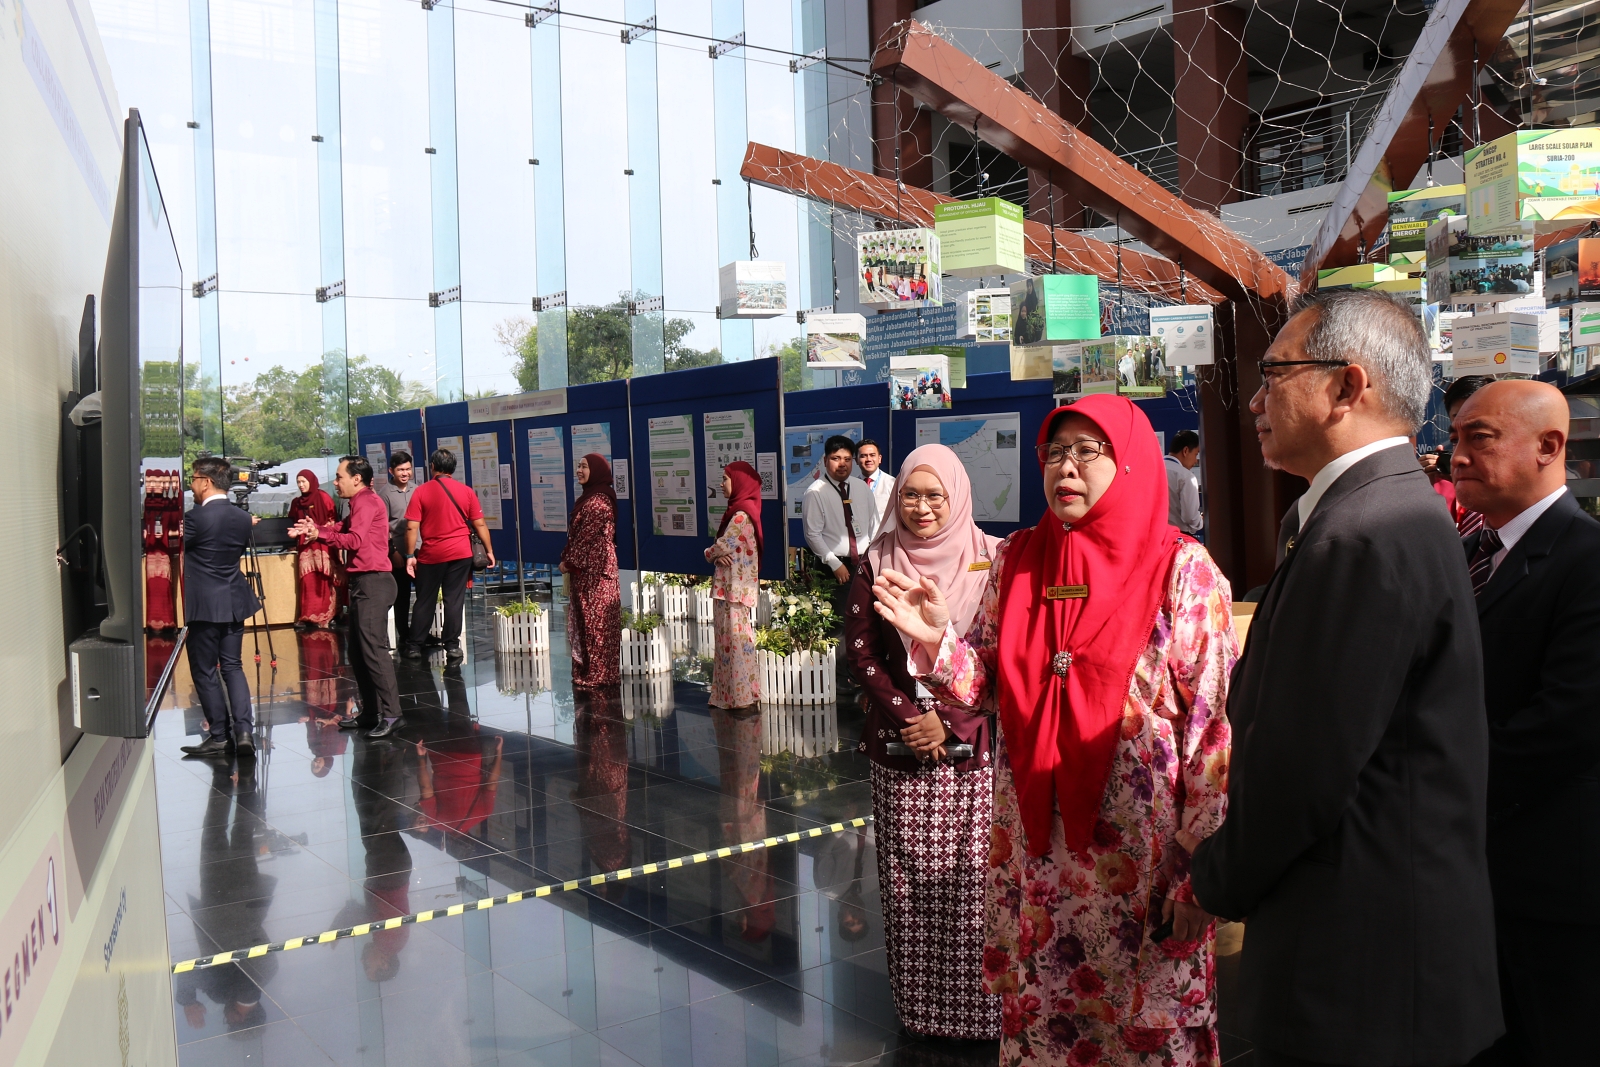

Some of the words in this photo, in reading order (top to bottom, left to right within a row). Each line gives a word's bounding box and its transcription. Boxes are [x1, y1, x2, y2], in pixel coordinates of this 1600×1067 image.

[1528, 143, 1544, 151] LARGE
[1547, 154, 1575, 162] SURIA-200
[1475, 156, 1495, 170] STRATEGY
[944, 204, 970, 212] PROTOKOL
[1392, 222, 1427, 230] RENEWABLE
[866, 309, 921, 325] ancangBandardanDes
[886, 318, 930, 331] JabatanKerjaRya
[866, 342, 889, 351] erumahan
[0, 903, 45, 1039] EGMEN
[47, 855, 59, 946] 1
